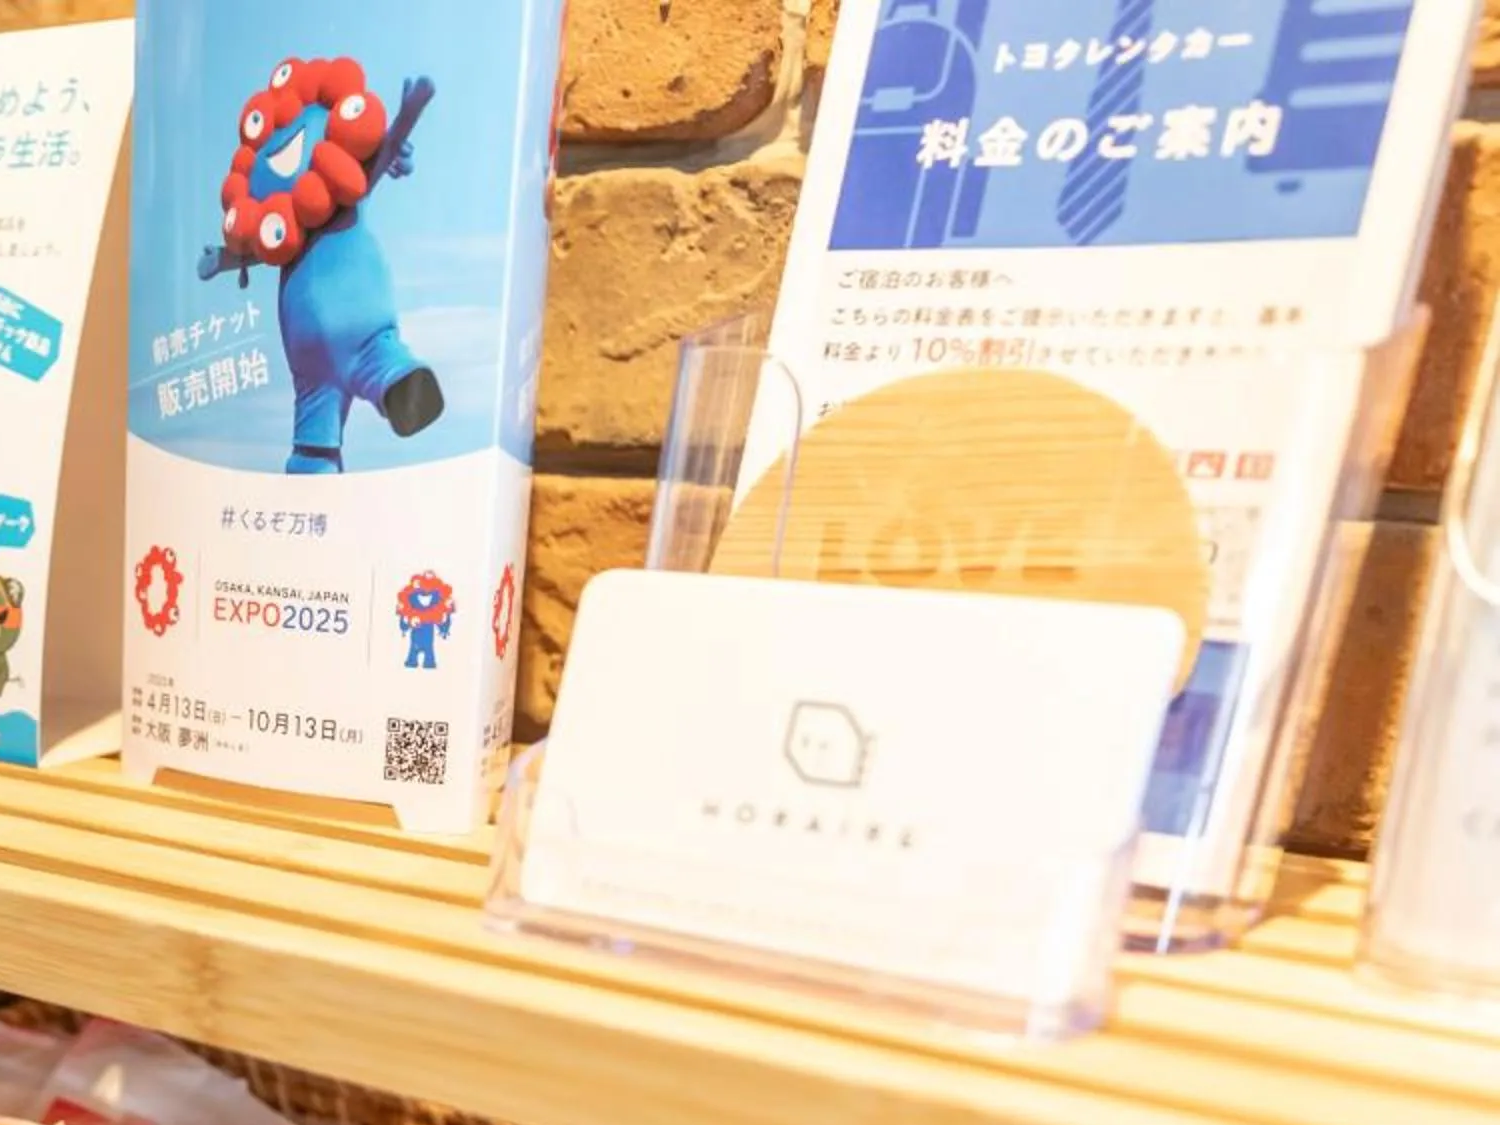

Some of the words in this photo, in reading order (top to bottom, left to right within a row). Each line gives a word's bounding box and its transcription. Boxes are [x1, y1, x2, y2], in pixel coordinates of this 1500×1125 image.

[994, 27, 1253, 73] トヨタレンタカー
[916, 101, 1283, 169] 料金のご案内
[837, 268, 1015, 290] ご宿泊のお客様へ
[152, 300, 261, 366] 前売チケット
[156, 348, 270, 420] 販売開始
[221, 505, 329, 538] #くるぞ万博
[213, 579, 255, 597] OSAKA,
[257, 584, 305, 602] KANSAI,
[306, 590, 350, 605] JAPAN
[212, 596, 349, 635] EXPO2025
